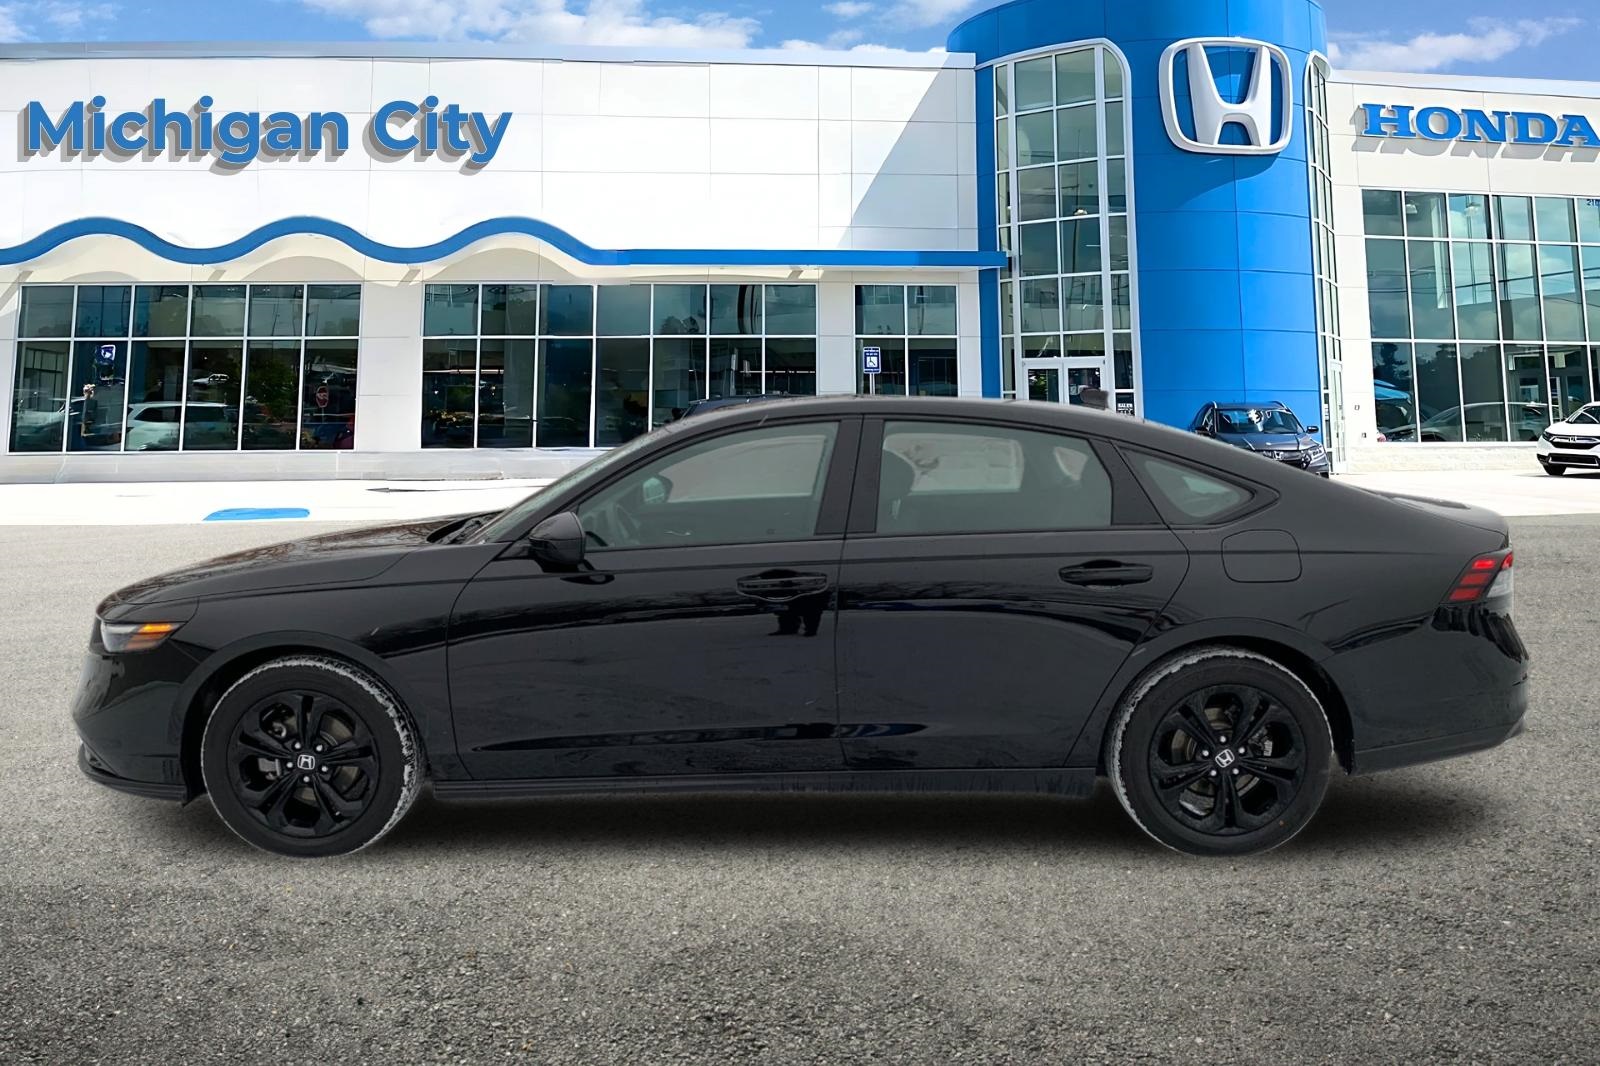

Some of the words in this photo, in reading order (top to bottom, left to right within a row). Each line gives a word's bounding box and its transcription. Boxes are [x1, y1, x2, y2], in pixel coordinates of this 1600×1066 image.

[26, 95, 350, 166] Michigan
[371, 95, 513, 166] City
[1361, 102, 1600, 148] HONDA
